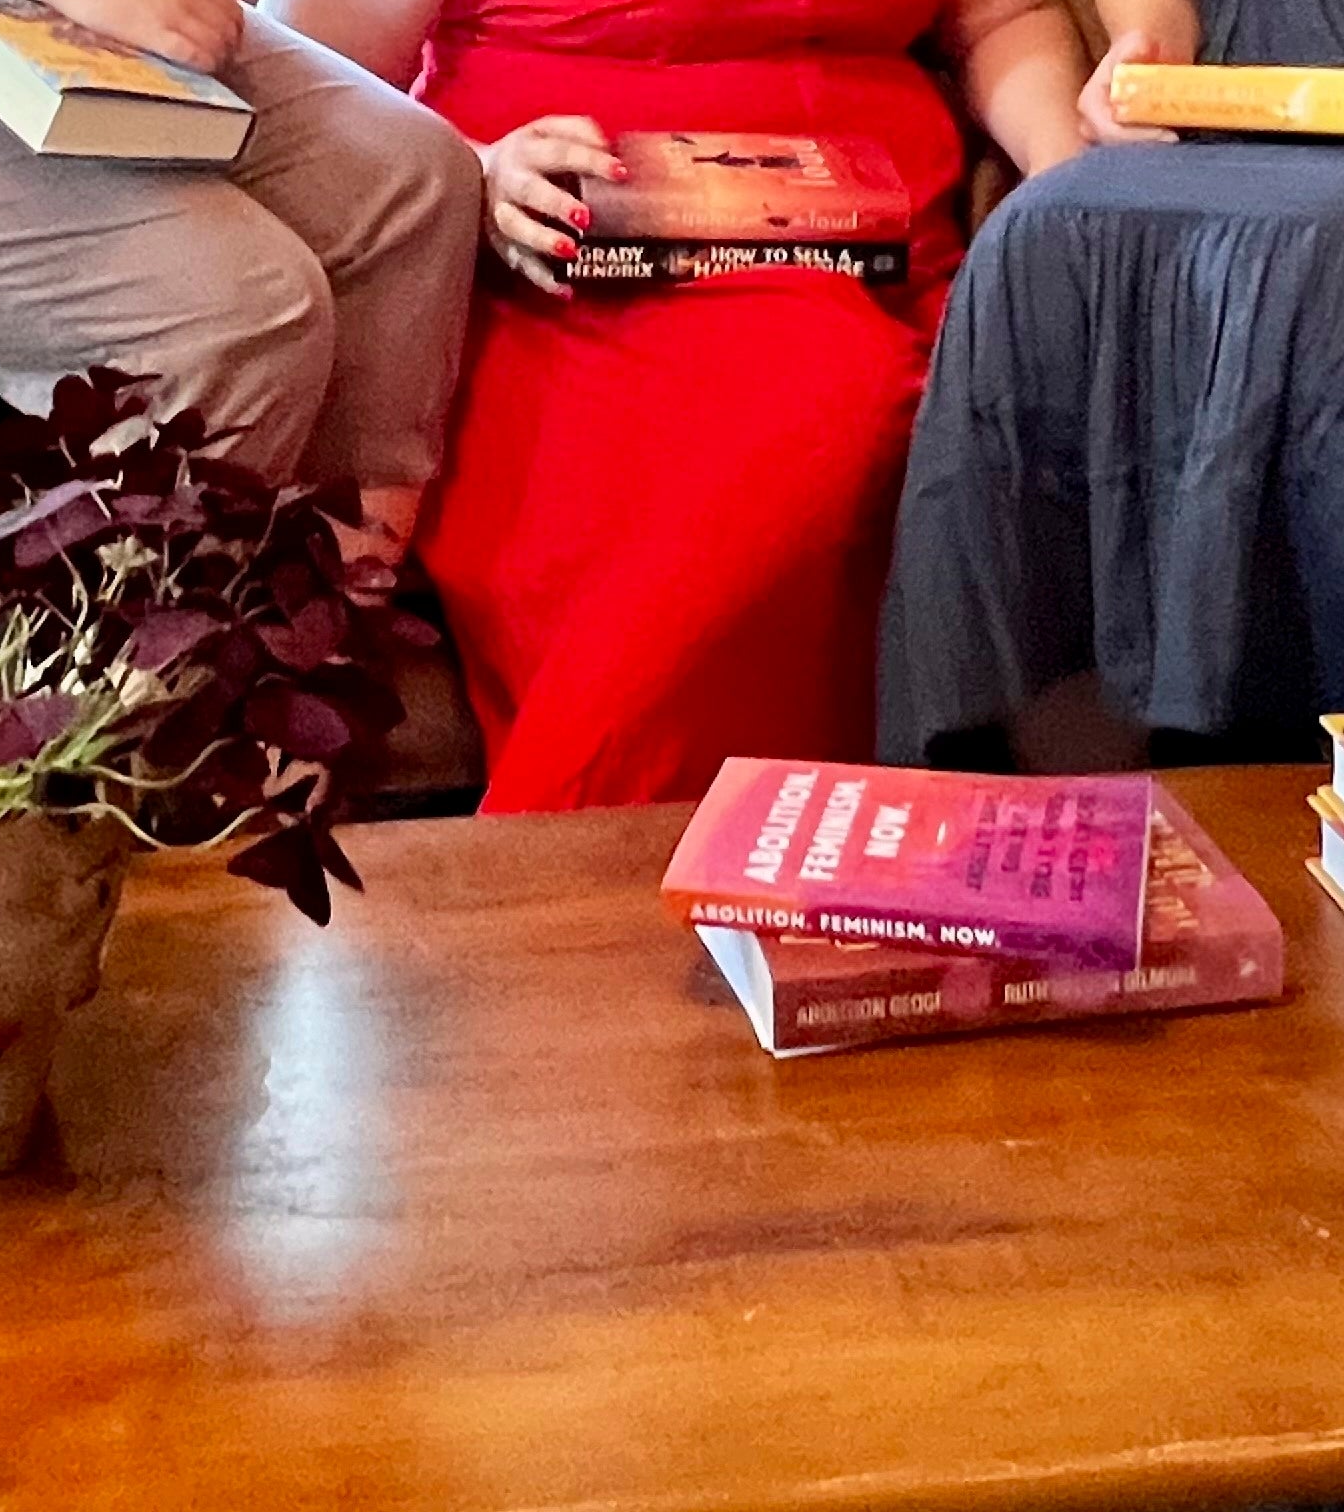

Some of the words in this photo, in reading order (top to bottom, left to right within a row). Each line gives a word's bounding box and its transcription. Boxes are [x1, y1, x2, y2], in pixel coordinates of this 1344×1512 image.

[577, 244, 645, 262] GRADY
[710, 244, 757, 263] HOW
[763, 246, 789, 263] TO
[793, 245, 834, 265] SELL
[566, 261, 654, 278] HENDRIX
[819, 912, 934, 943] FEMINISM.
[939, 925, 1002, 948] NOW.
[1003, 980, 1049, 1005] RUTH
